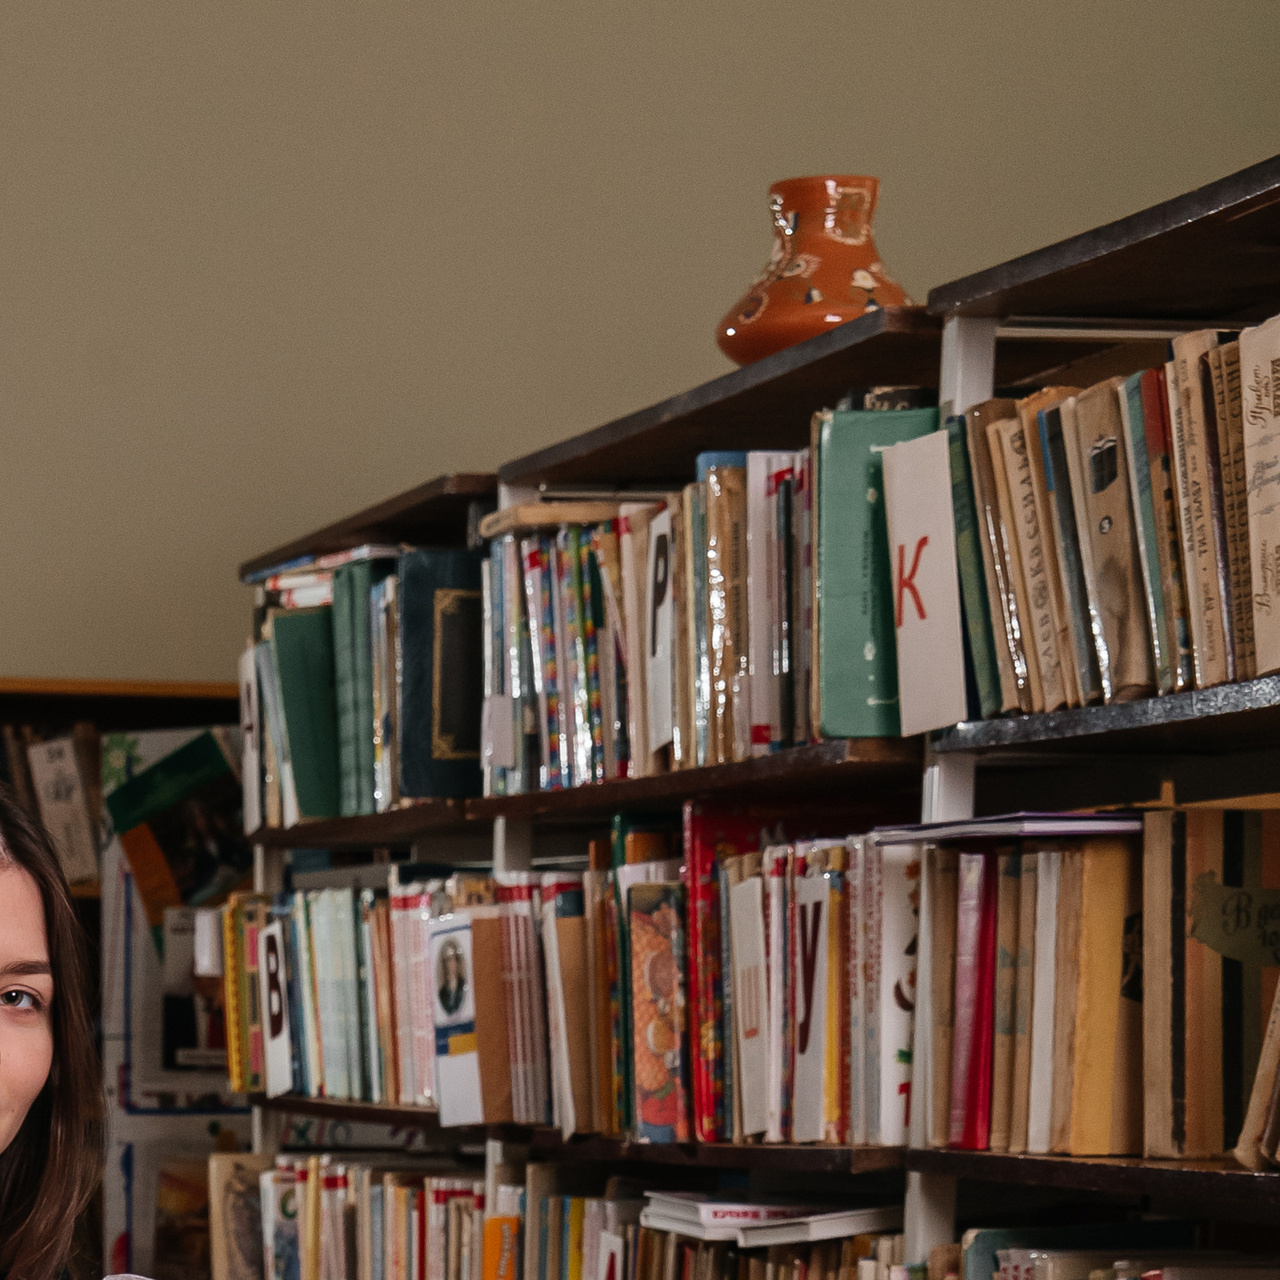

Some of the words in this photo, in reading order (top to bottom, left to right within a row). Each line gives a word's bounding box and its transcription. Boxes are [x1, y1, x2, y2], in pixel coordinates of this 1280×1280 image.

[1244, 364, 1273, 430] Привет
[650, 532, 669, 658] Р
[896, 536, 930, 629] К
[797, 899, 824, 1056] У
